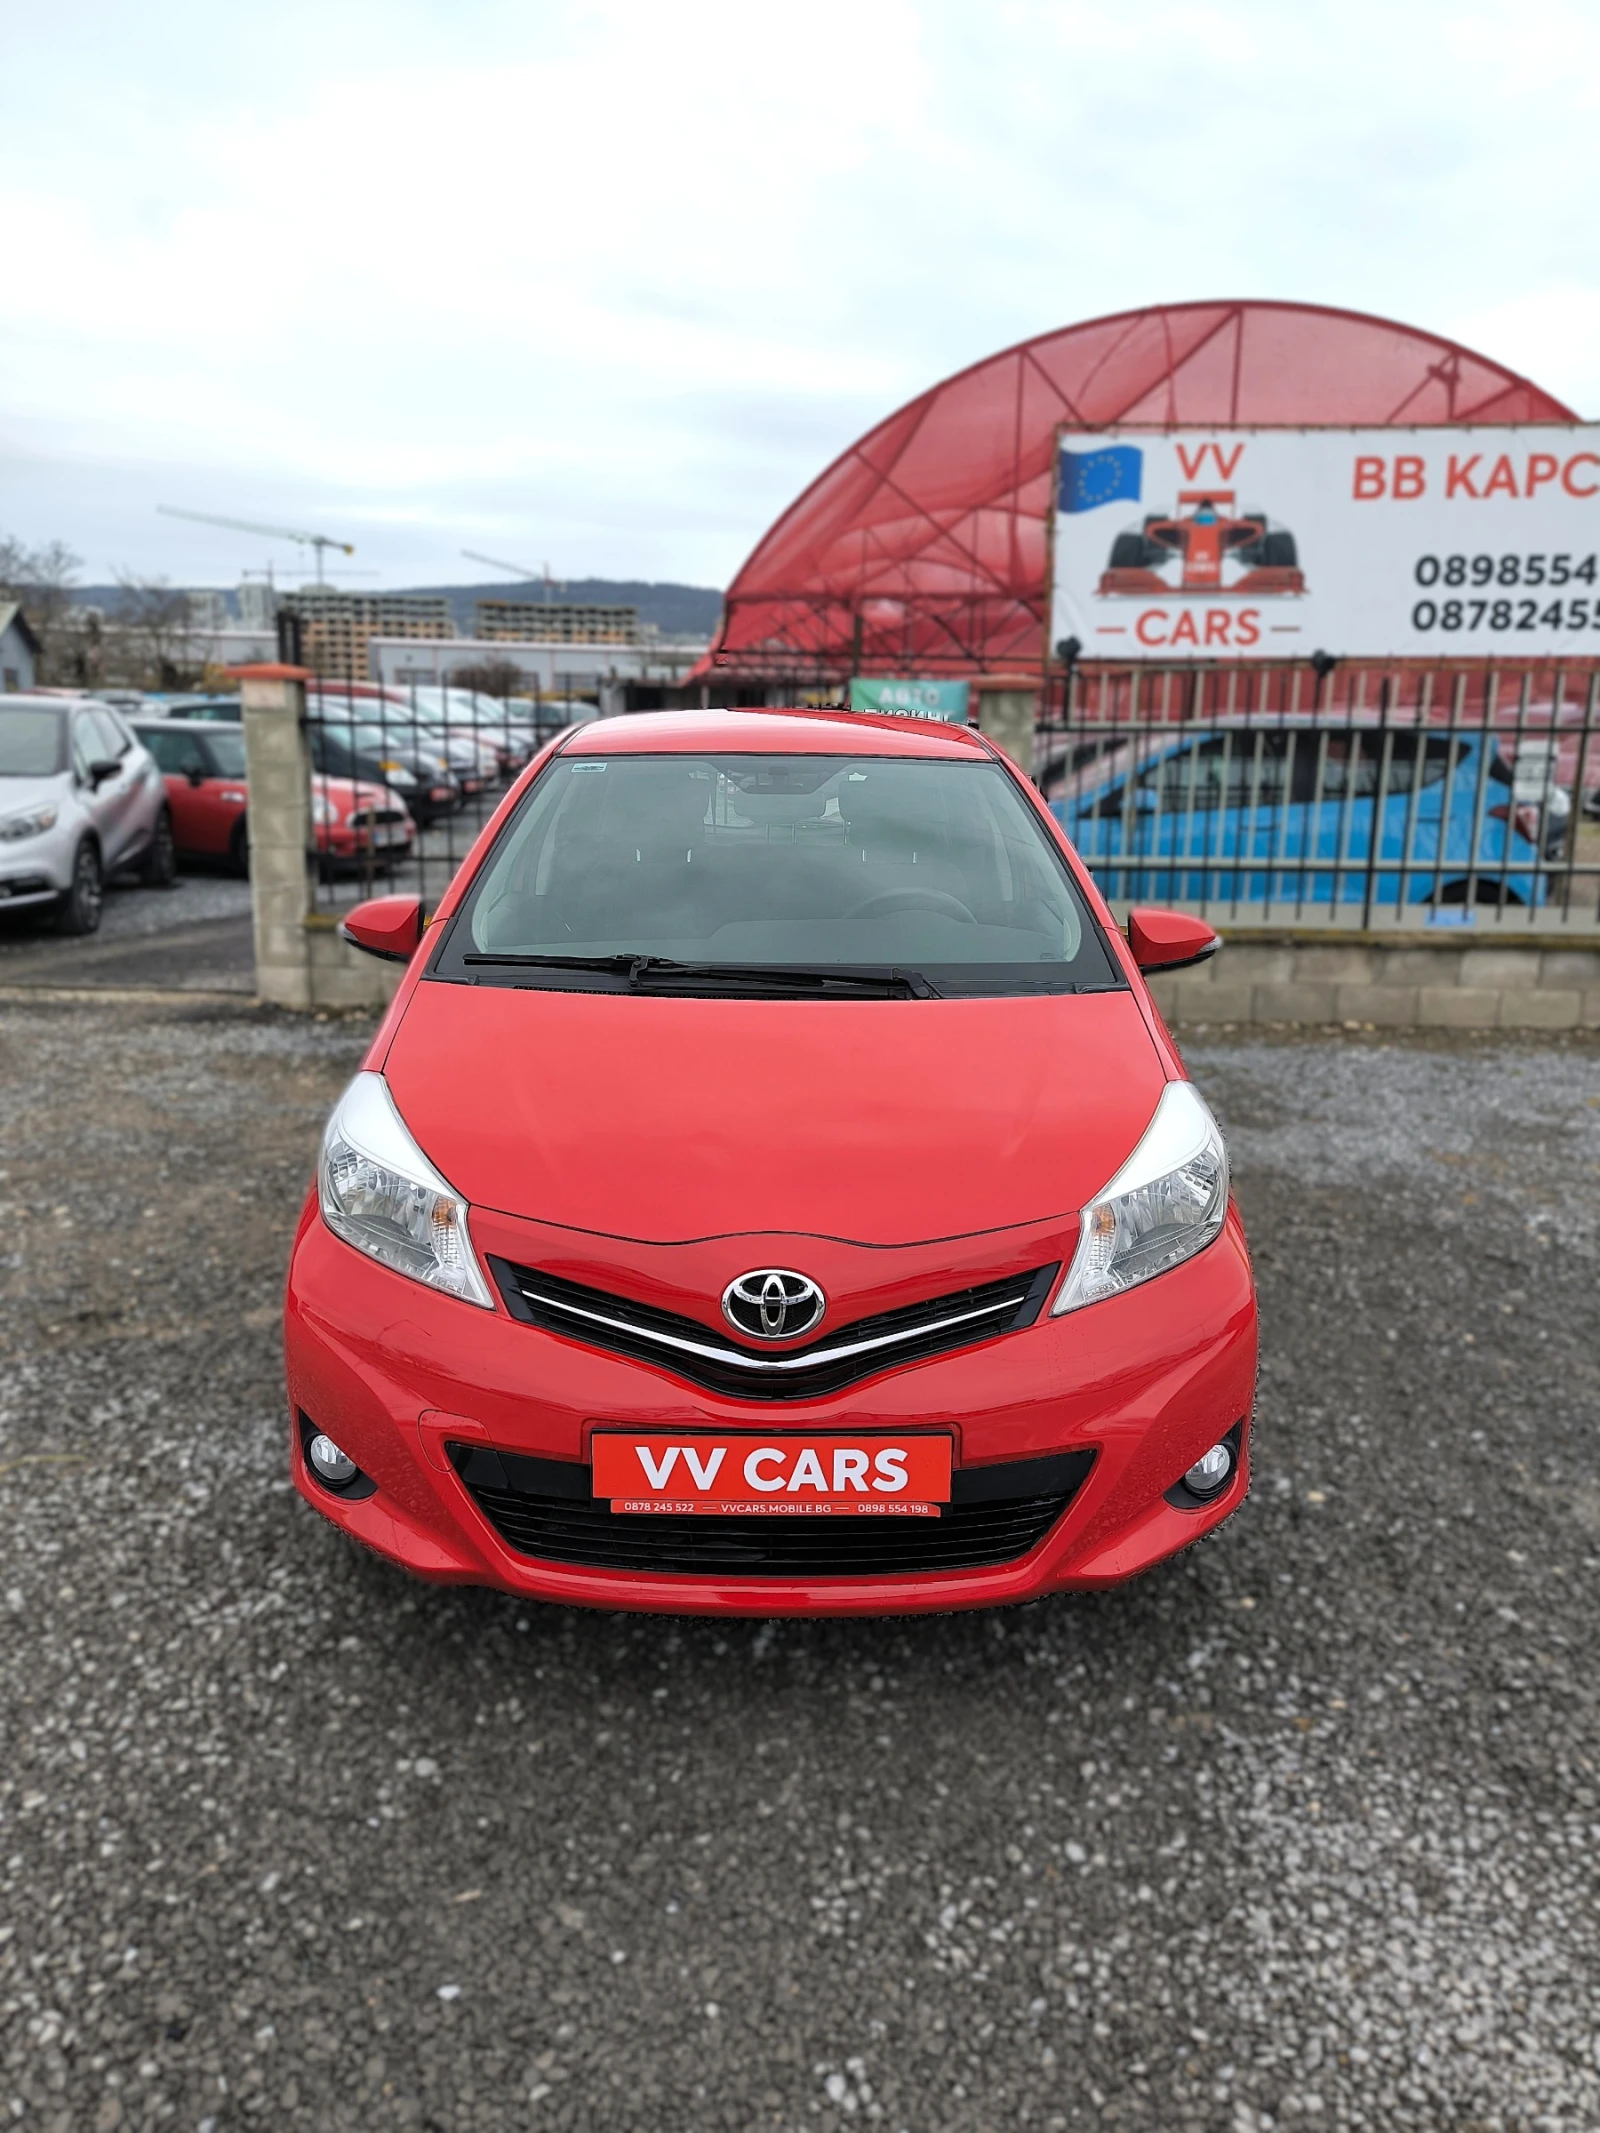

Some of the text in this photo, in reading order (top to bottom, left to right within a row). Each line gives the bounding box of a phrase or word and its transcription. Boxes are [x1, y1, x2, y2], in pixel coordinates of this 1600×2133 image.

[1175, 443, 1245, 482] VV
[1414, 554, 1598, 588] 0898554
[1134, 608, 1261, 647] CARS
[634, 1446, 909, 1493] VV CARS
[624, 1502, 929, 1515] 0878 245 522 VVCARS.MOBILE.BG 0898 554 198
